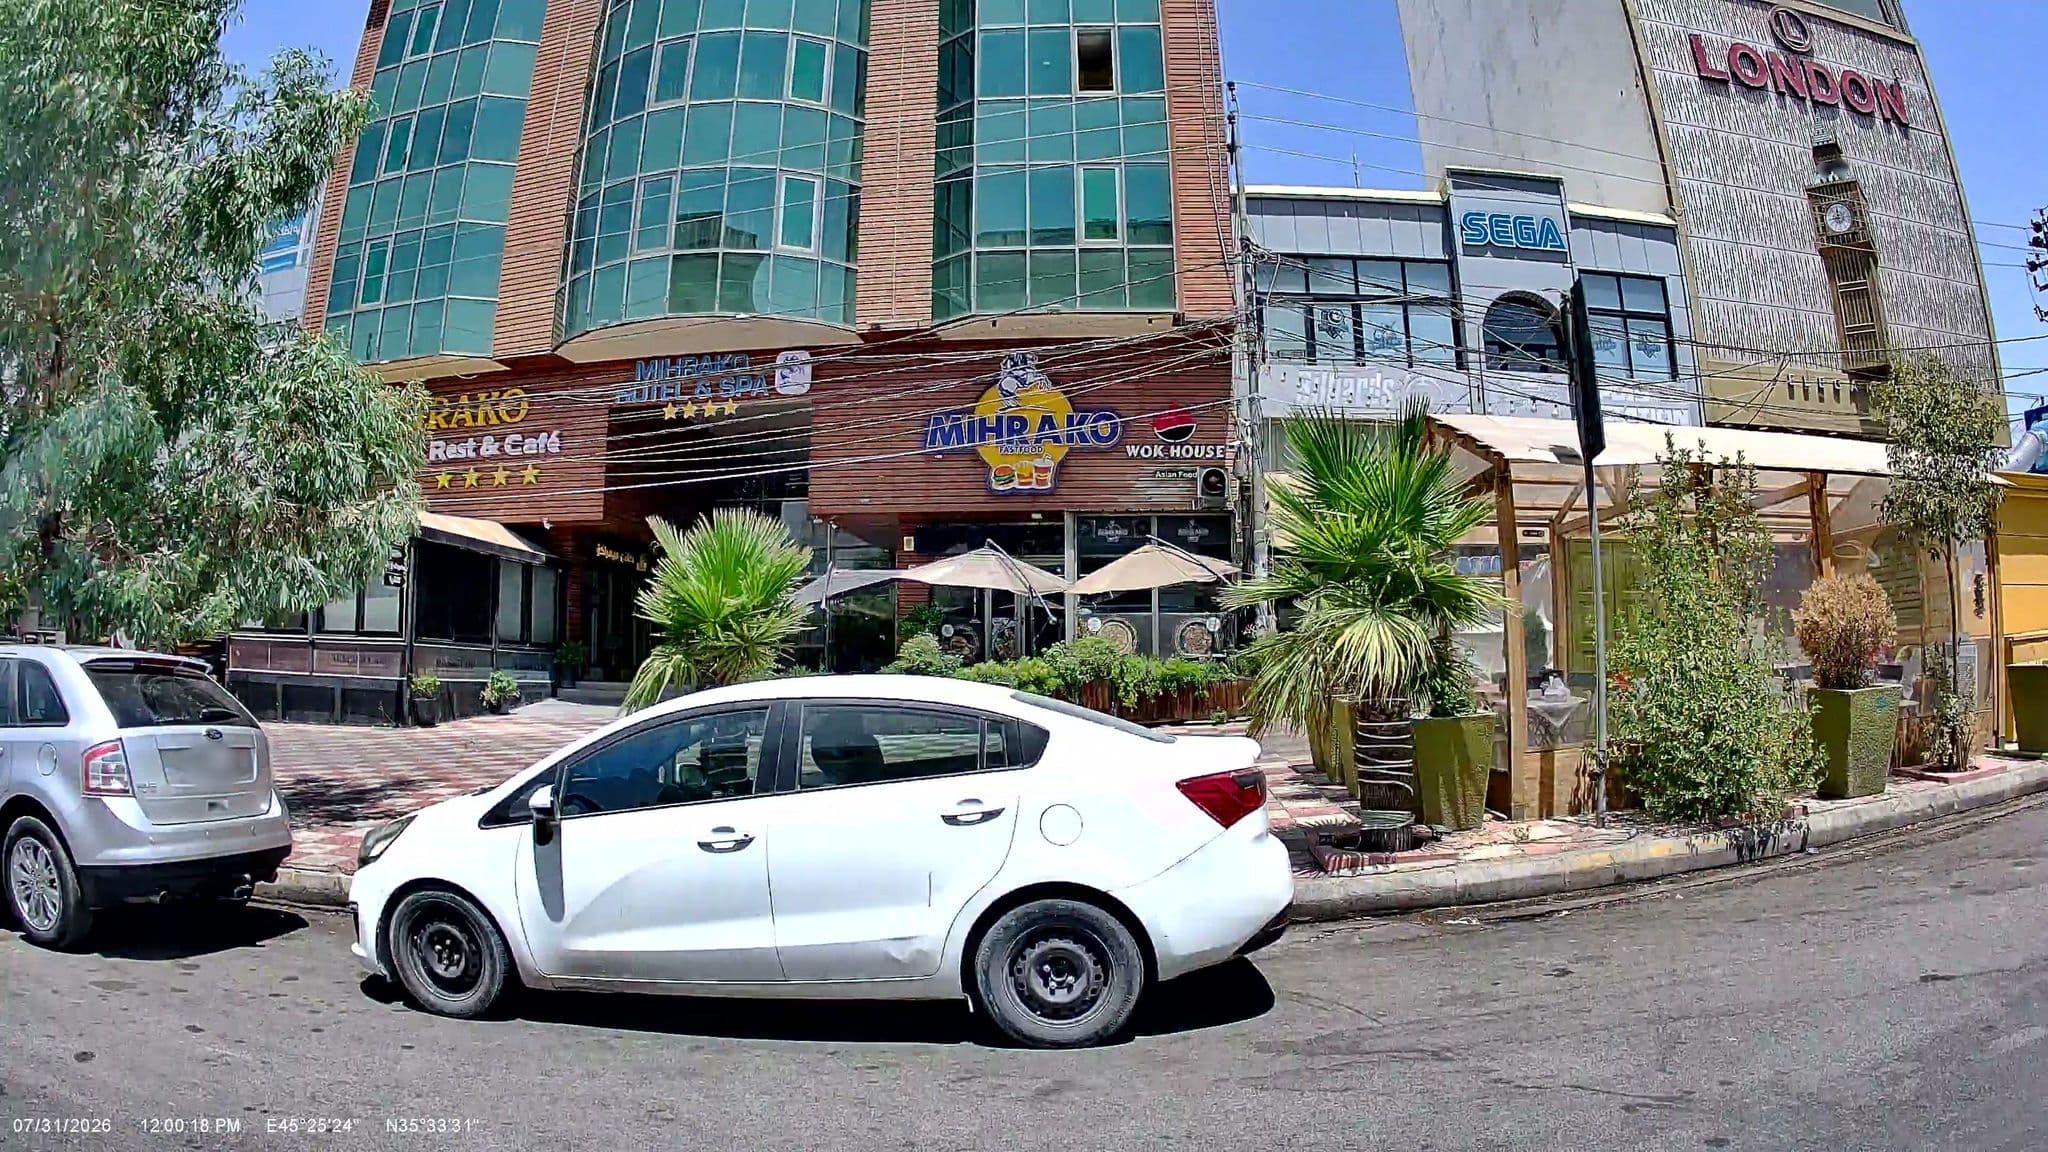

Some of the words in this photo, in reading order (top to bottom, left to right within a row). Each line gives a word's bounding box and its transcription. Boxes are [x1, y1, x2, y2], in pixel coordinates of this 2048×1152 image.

[1689, 33, 1909, 124] LONDON
[1461, 210, 1569, 252] SEGA
[635, 353, 750, 381] MIHRAKO
[695, 378, 713, 398] &
[720, 374, 769, 398] SPA
[426, 388, 529, 430] RAKO
[429, 437, 477, 463] Rest
[479, 435, 500, 458] &
[504, 430, 561, 456] Café
[927, 411, 1122, 449] MIHRAKO
[1126, 445, 1165, 458] WOK
[1170, 445, 1225, 458] HOUSE
